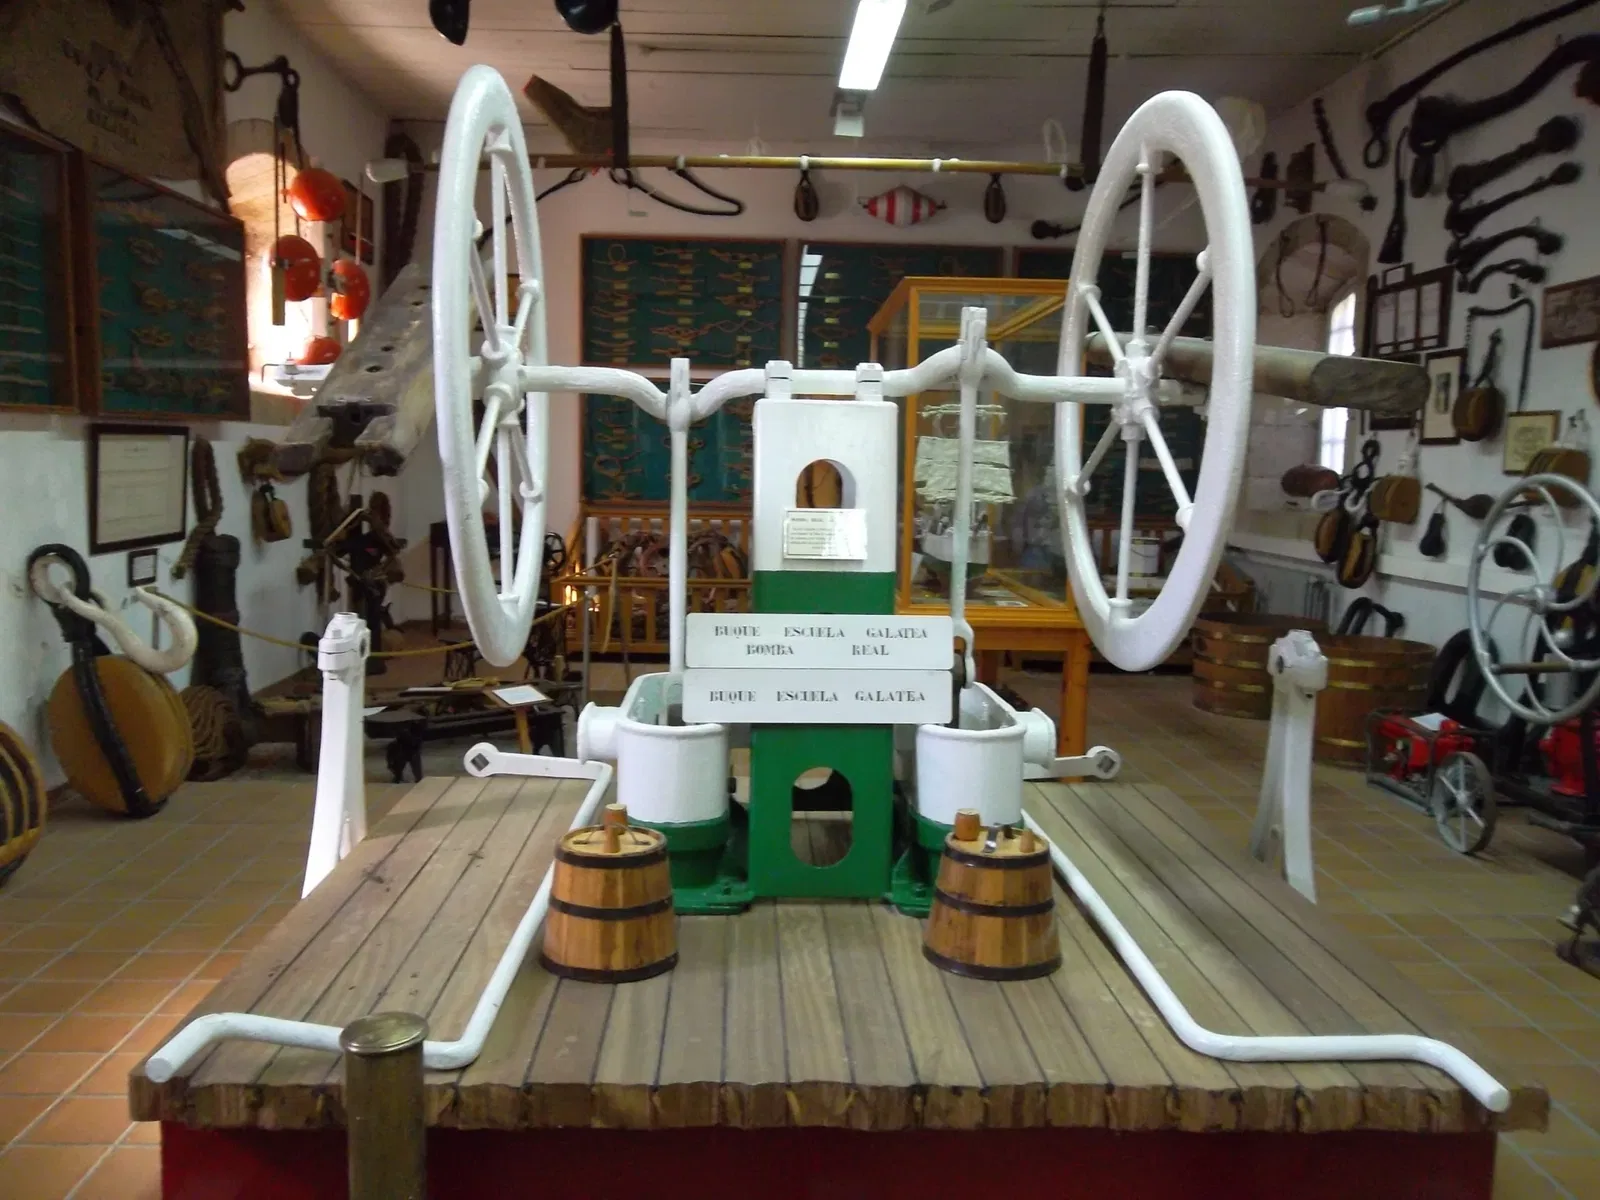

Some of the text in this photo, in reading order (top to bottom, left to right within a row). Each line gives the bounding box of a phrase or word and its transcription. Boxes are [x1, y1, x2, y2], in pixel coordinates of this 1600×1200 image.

[714, 625, 928, 639] BUQUE ESCUELA GALATEA
[746, 644, 889, 656] BOMBA REAL
[709, 690, 925, 704] BUQUE ESCUELA GALATEA
